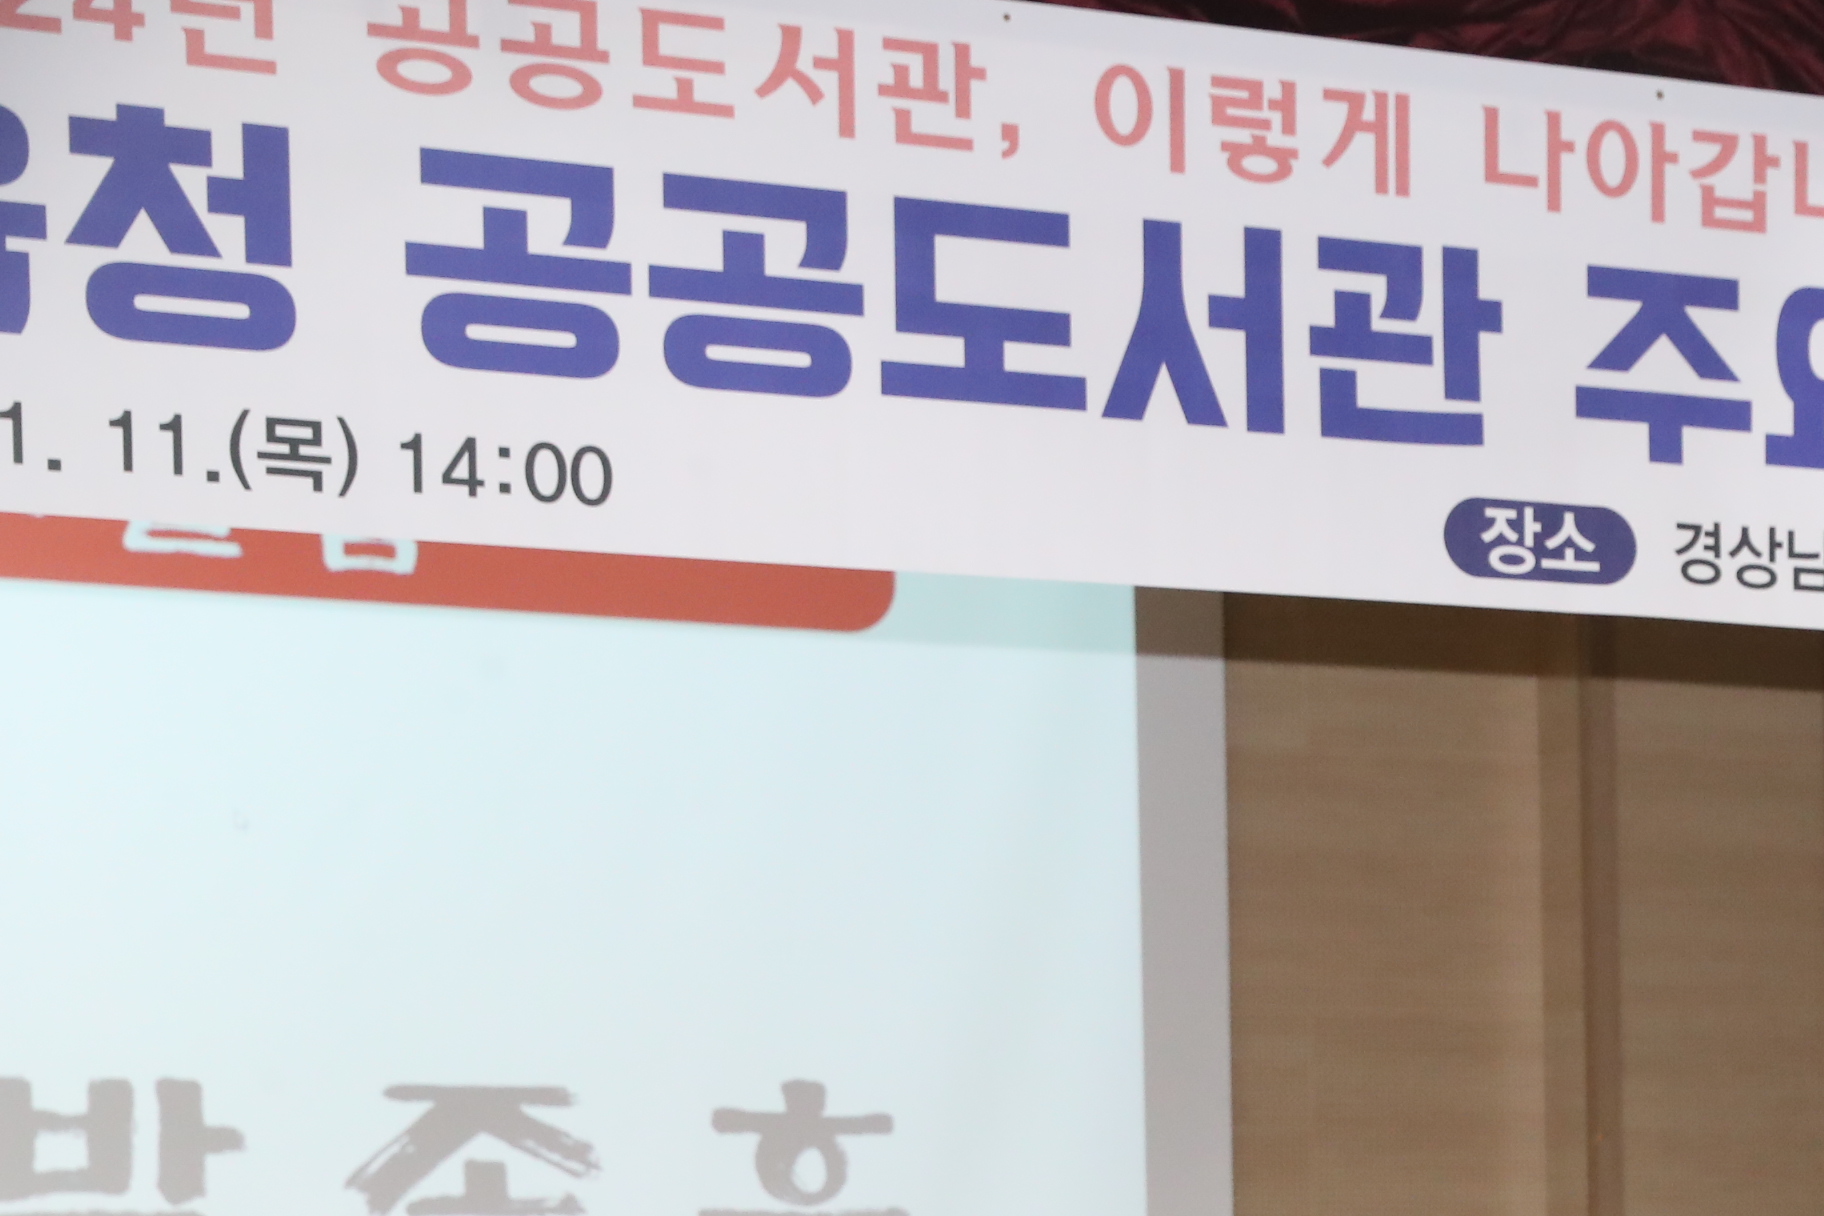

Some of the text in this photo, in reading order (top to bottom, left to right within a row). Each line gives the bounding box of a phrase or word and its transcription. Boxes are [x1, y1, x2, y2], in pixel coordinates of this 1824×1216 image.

[366, 0, 1020, 158] 공공도서관,
[1093, 63, 1411, 198] 이렇게
[0, 104, 297, 351] 청
[405, 147, 1503, 446] 공공도서관
[109, 409, 358, 497] 11.(목)
[400, 432, 613, 506] 14:00
[1479, 505, 1602, 575] 장소
